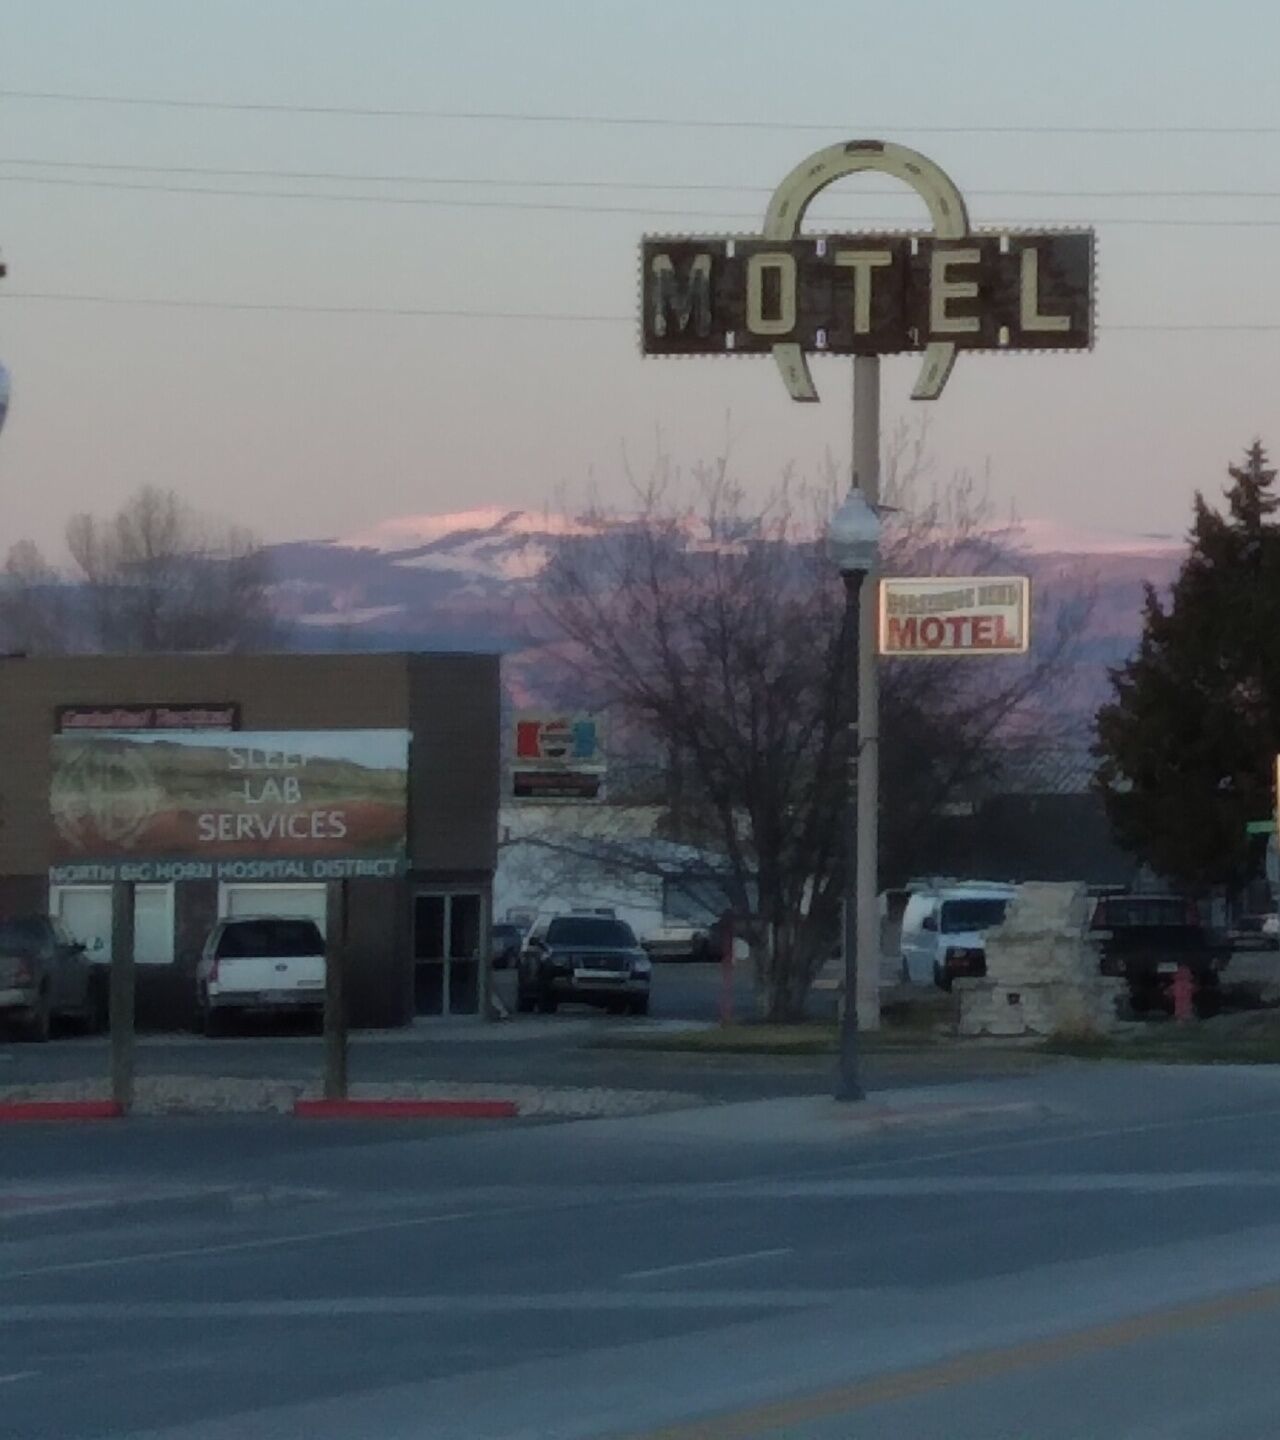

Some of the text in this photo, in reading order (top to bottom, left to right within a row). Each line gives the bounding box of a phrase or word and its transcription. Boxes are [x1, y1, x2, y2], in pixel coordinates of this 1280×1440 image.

[651, 247, 1071, 337] MOTEL
[888, 615, 1016, 649] MOTEL
[244, 776, 302, 804] LAB
[198, 810, 348, 842] SERVICES
[217, 860, 310, 879] HOSPITAL
[312, 859, 398, 878] DISTRICT
